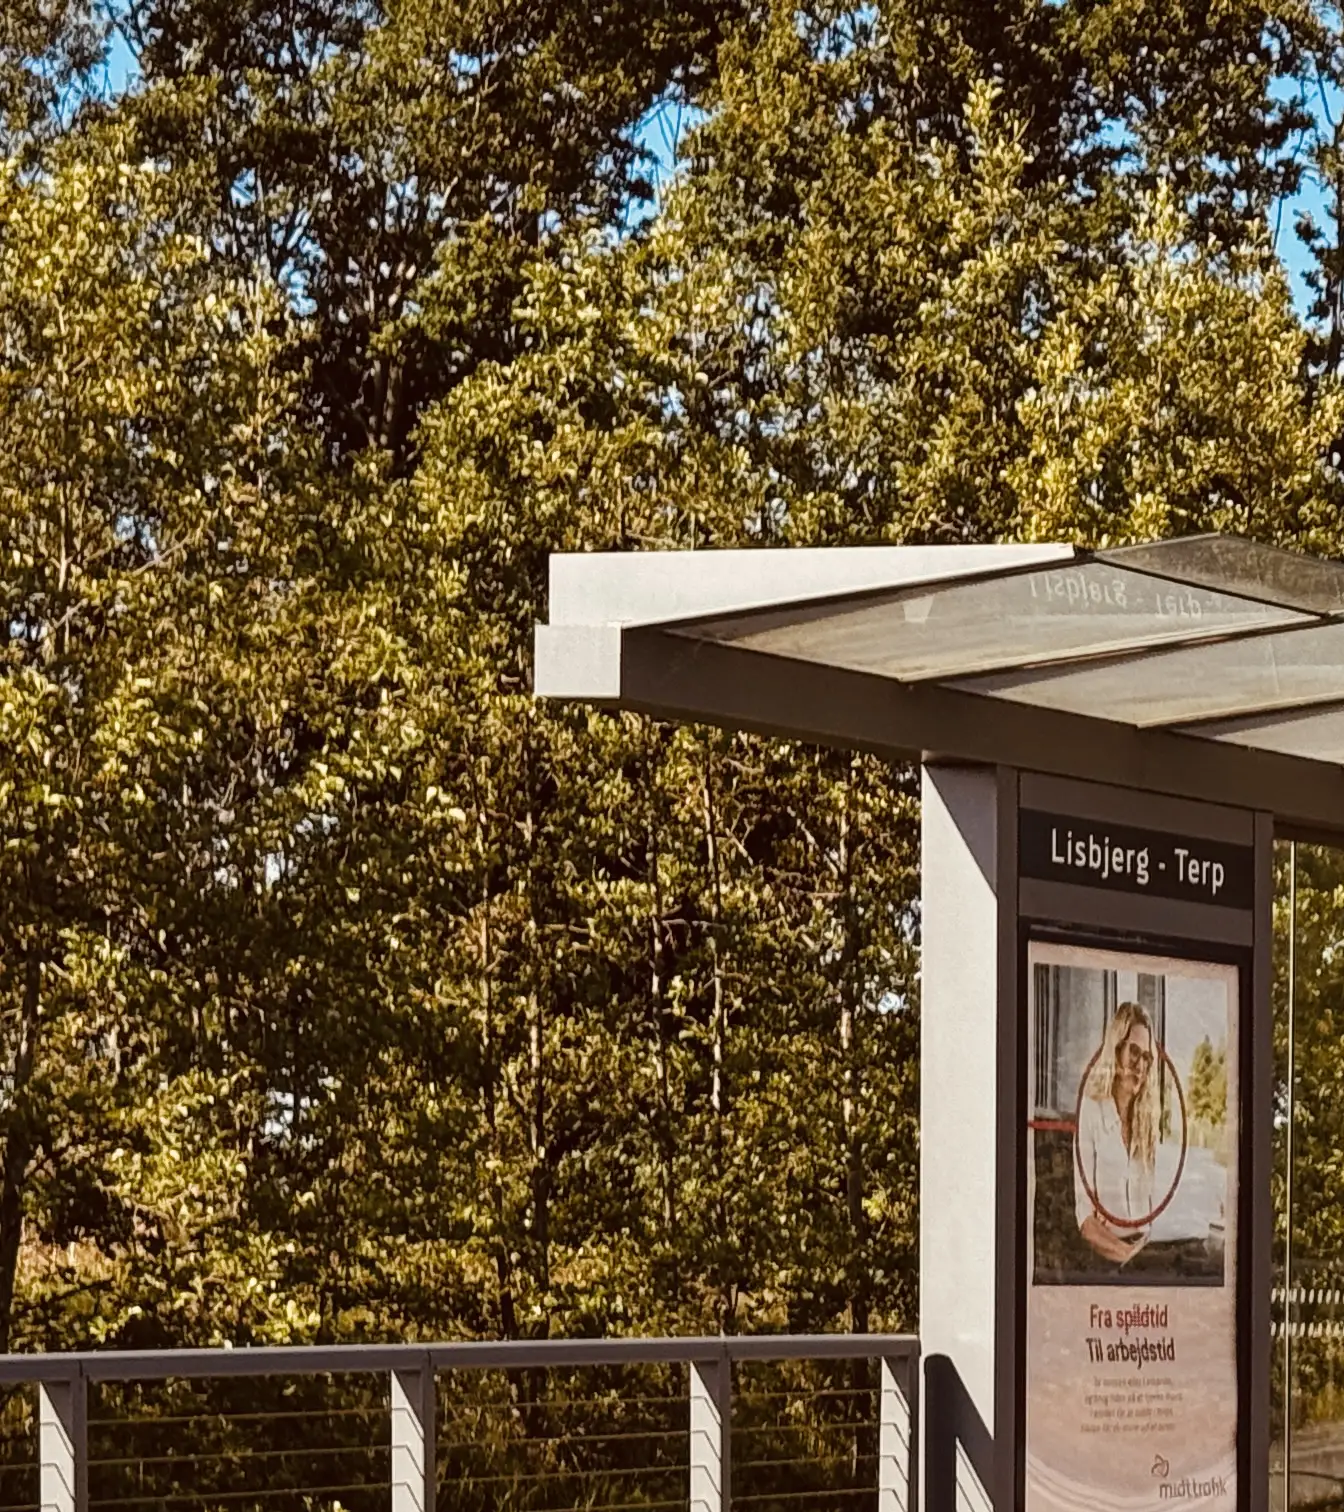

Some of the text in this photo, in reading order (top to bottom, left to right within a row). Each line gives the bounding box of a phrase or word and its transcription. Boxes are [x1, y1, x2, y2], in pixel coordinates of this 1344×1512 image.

[1051, 827, 1150, 885] Lisbjerg
[1174, 848, 1225, 895] Terp
[1089, 1303, 1169, 1336] Fra spildtid
[1085, 1337, 1176, 1370] Til arbejdstid
